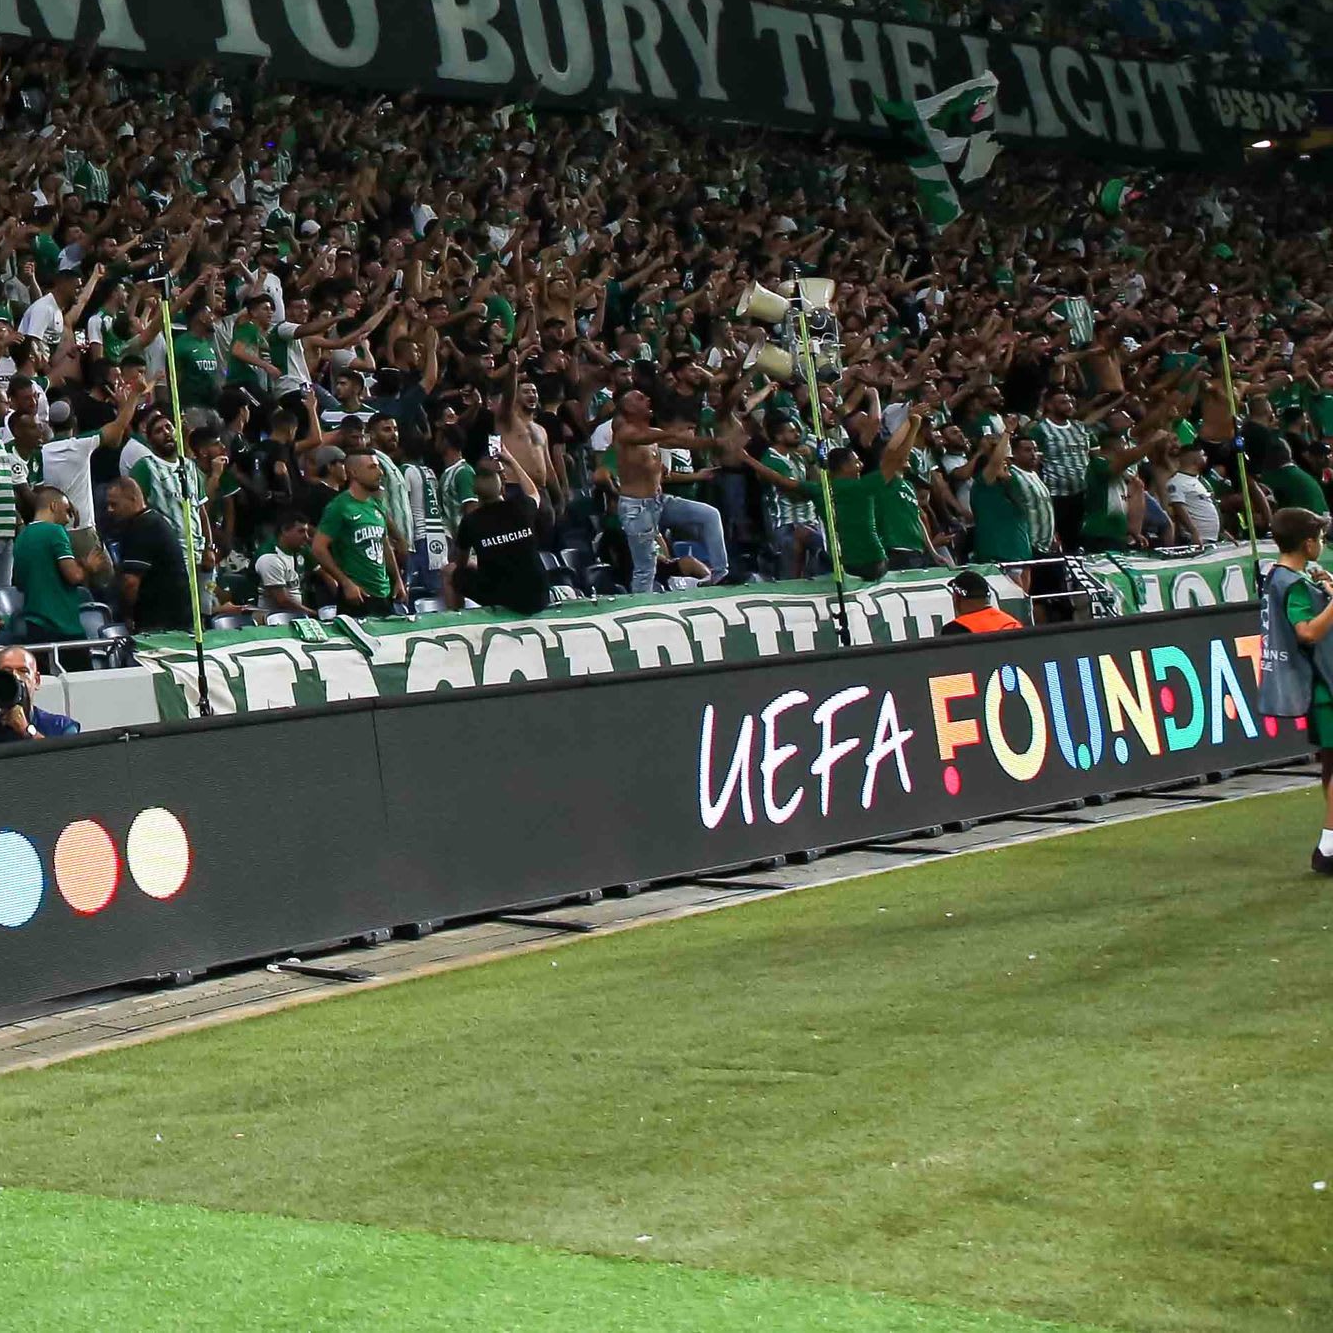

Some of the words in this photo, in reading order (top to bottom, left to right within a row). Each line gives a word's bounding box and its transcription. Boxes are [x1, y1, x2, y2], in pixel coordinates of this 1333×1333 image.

[750, 1, 937, 129] THE
[962, 35, 1203, 153] LIGHT
[481, 527, 533, 548] BALENCIAGA
[698, 685, 914, 830] UEFA
